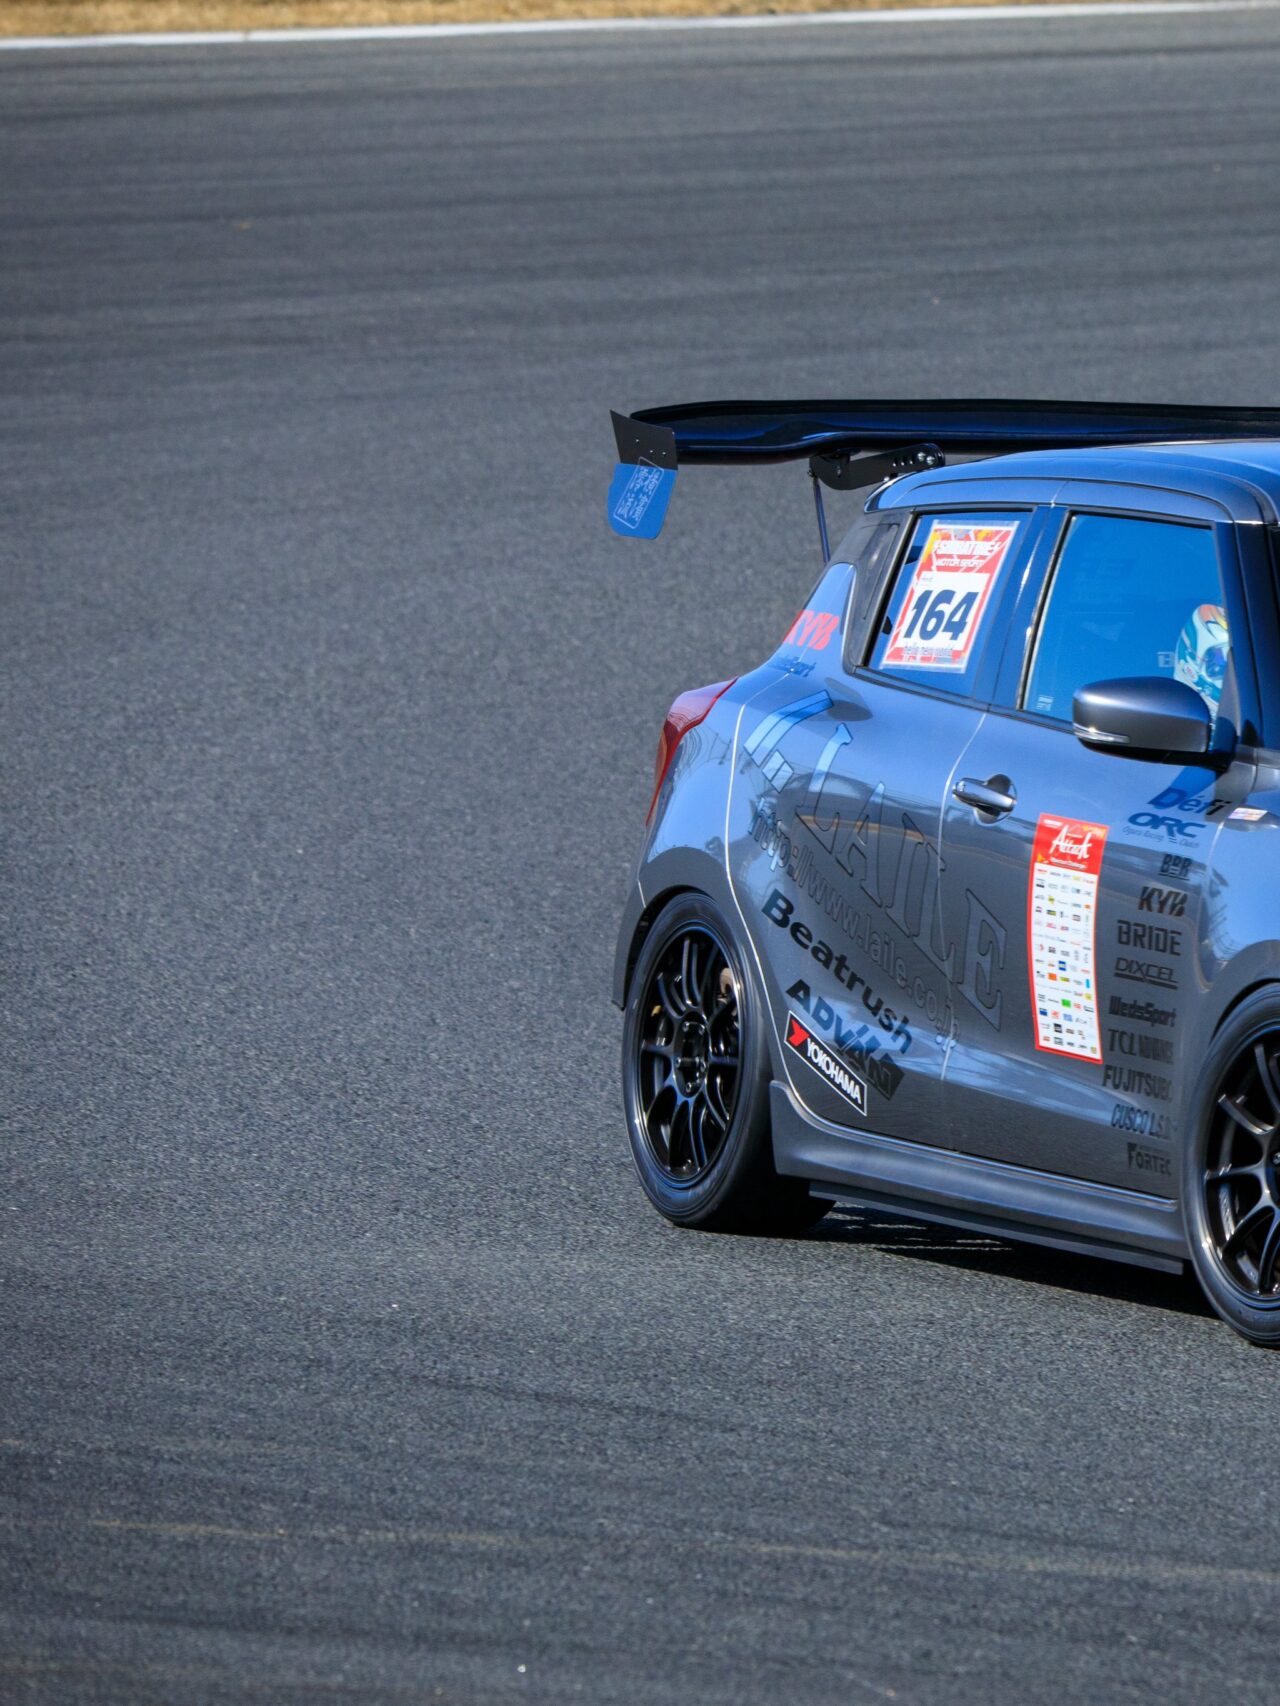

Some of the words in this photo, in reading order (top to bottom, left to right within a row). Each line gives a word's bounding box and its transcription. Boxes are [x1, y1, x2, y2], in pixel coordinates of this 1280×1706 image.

[903, 589, 979, 641] 164
[1127, 812, 1208, 838] ORC
[1138, 886, 1188, 917] KYB
[1117, 919, 1182, 957] BRIDE
[761, 888, 912, 1054] Beatrush
[1115, 957, 1179, 984] DIXCEL
[786, 979, 904, 1100] ADVAN
[1108, 1028, 1137, 1056] TCL
[806, 1037, 862, 1105] YOKOHAMA
[1110, 1103, 1149, 1134] CUSCO
[1127, 1142, 1172, 1176] FORTEC
